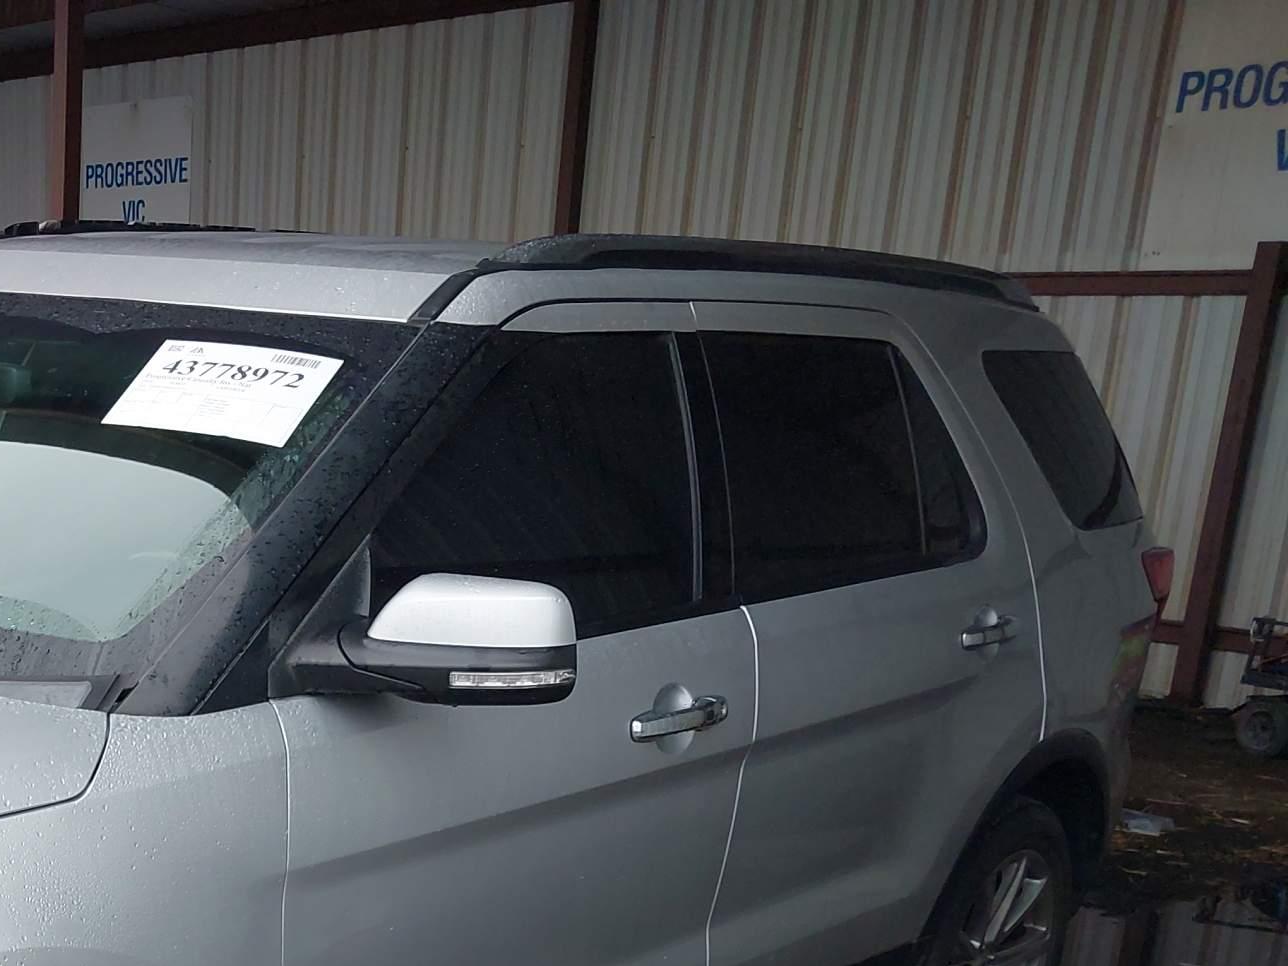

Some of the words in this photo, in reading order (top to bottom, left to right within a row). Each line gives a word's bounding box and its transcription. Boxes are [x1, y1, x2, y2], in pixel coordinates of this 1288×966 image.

[1176, 61, 1288, 113] PROG
[86, 157, 188, 189] PROGRESSIVE
[122, 200, 145, 223] VIC
[162, 359, 305, 389] 43778972
